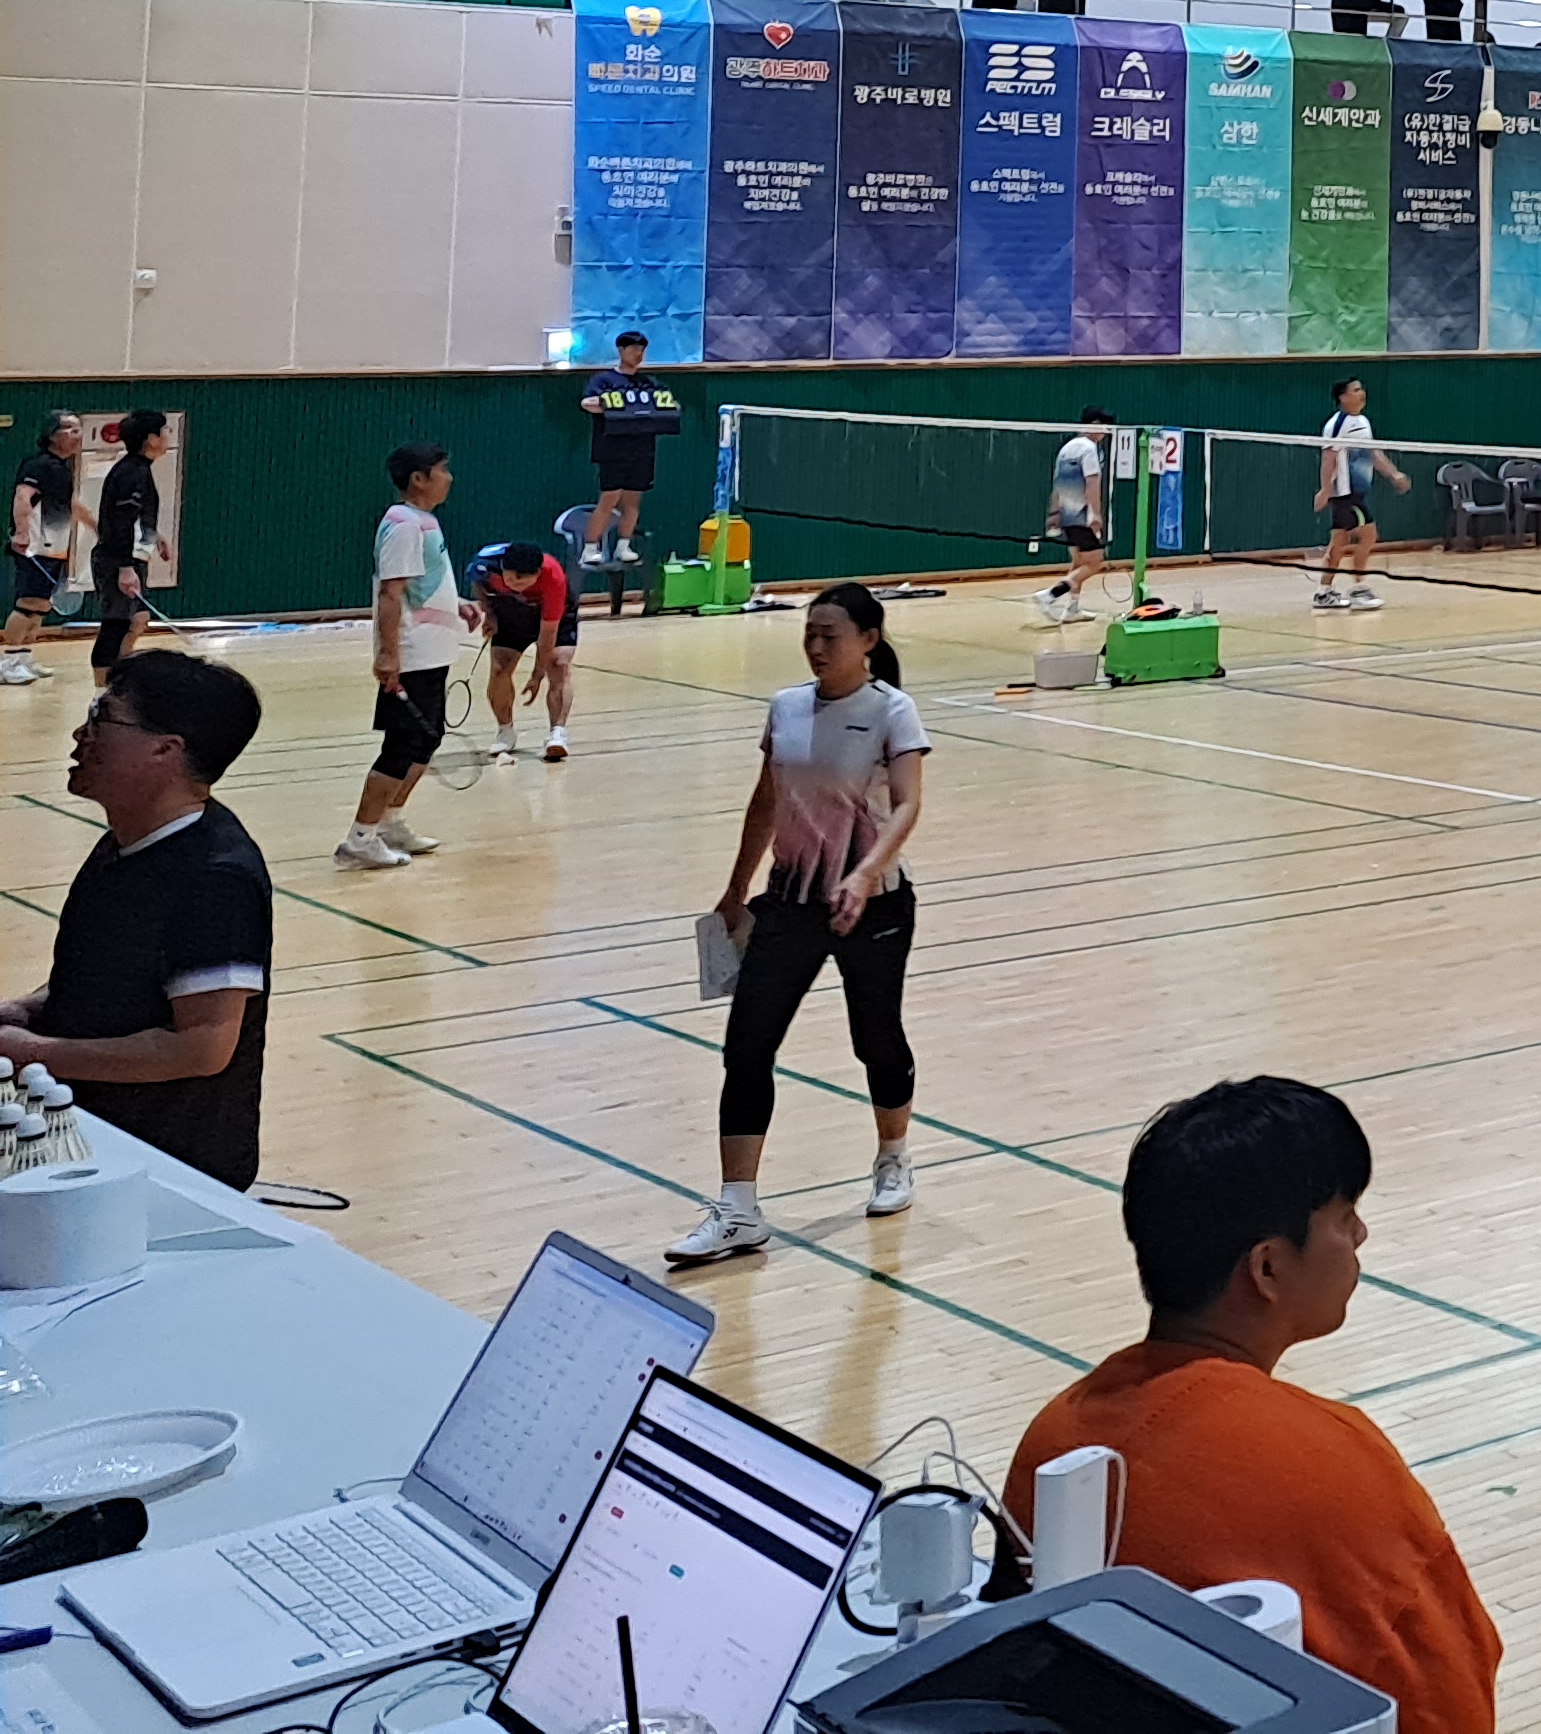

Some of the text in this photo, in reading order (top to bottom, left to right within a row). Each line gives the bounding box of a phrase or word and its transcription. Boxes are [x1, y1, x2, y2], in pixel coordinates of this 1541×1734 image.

[625, 44, 662, 62] 화순
[853, 85, 951, 107] 광주바로병원
[1208, 82, 1272, 98] SAMHAN
[976, 111, 1061, 136] 스펙트럼
[1301, 106, 1382, 128] 신세계안과
[1091, 116, 1171, 141] 크레슬리
[1220, 120, 1260, 145] 삼한
[1404, 131, 1470, 149] 자동차정비
[1417, 149, 1457, 165] 서비스
[601, 391, 625, 408] 18
[626, 390, 649, 403] 0 0
[653, 391, 676, 408] 22
[1166, 437, 1177, 463] 2
